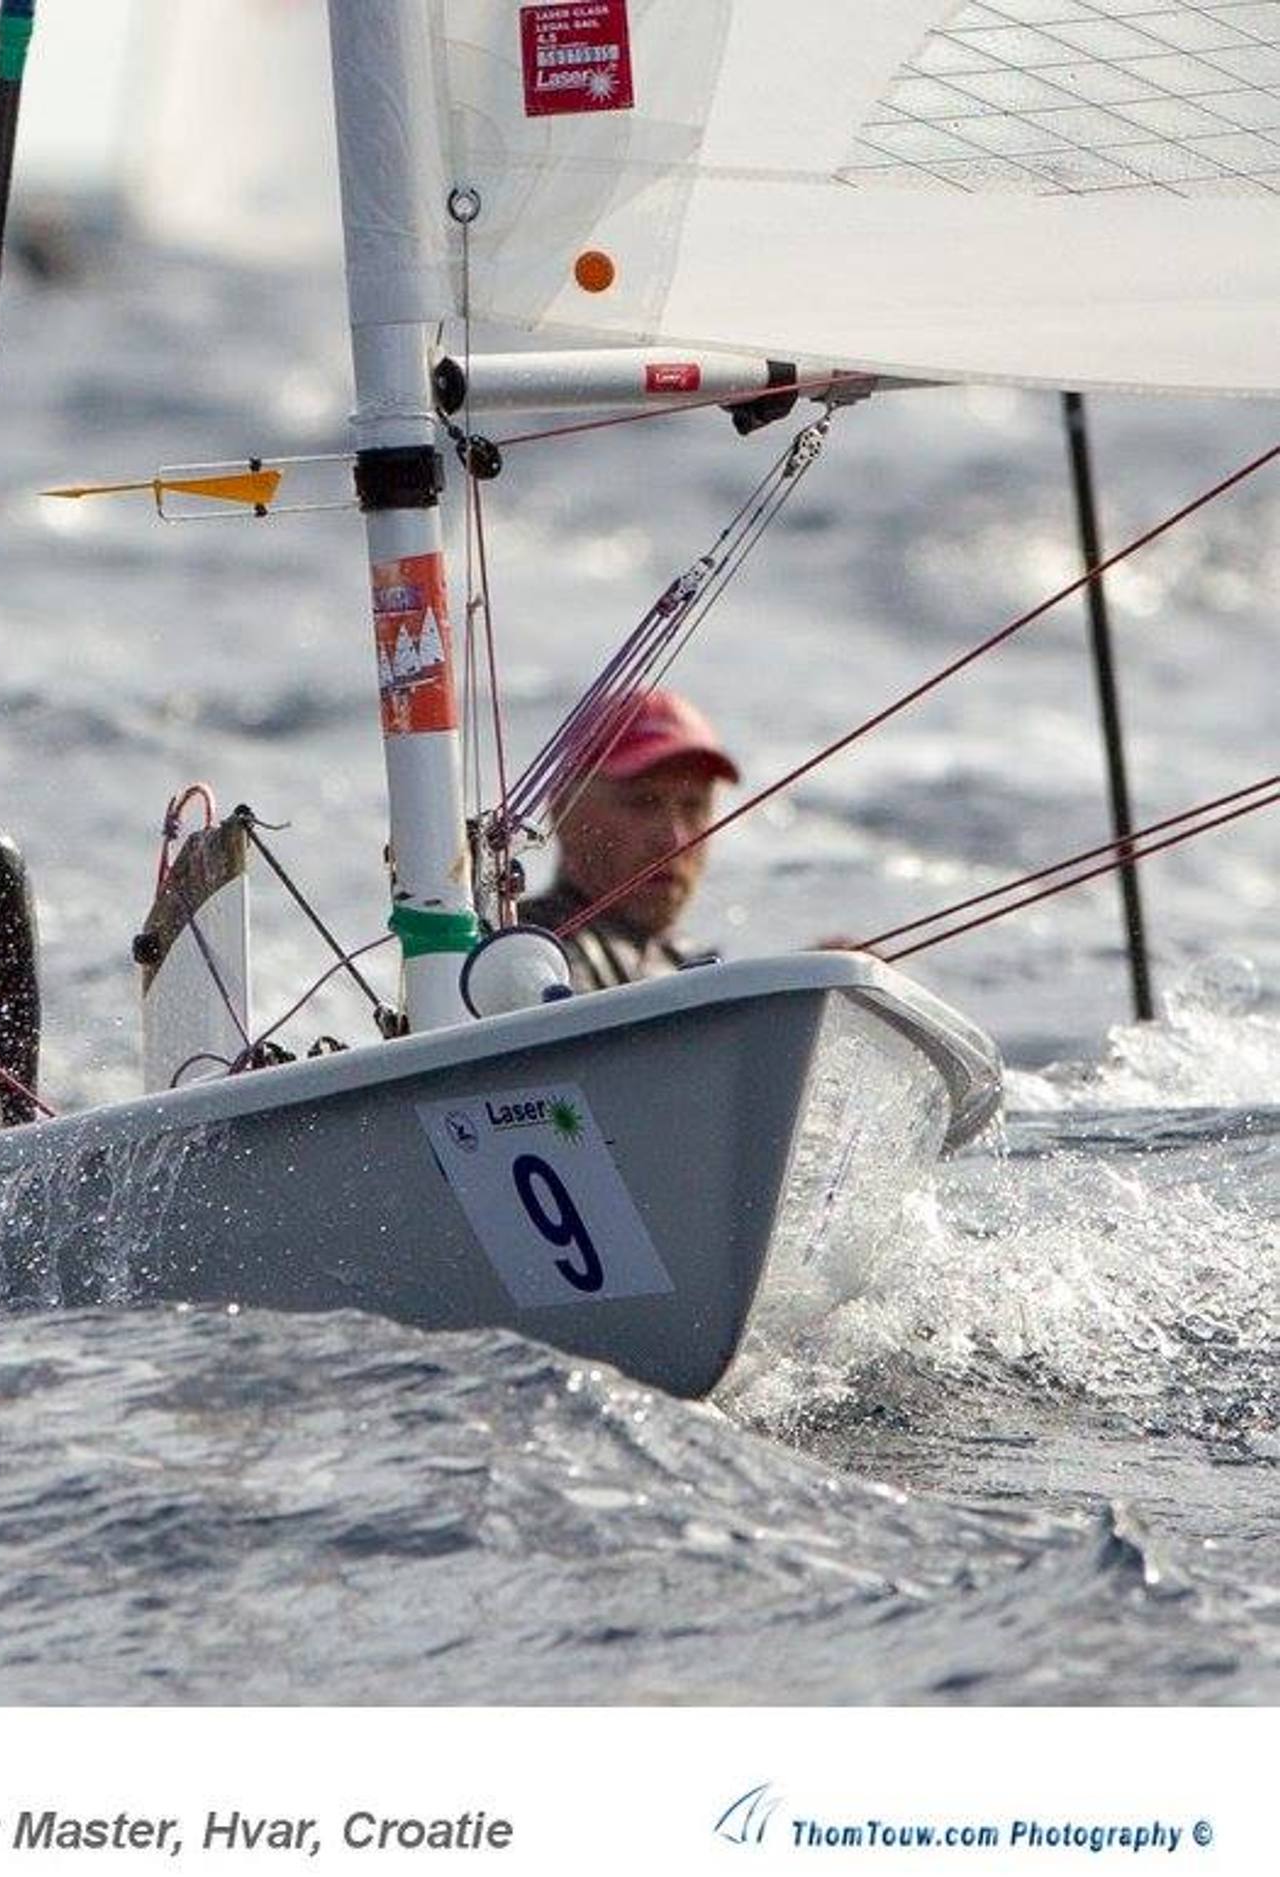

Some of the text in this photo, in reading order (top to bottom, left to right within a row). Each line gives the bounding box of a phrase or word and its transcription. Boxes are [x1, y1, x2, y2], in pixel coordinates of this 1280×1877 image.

[536, 69, 589, 87] Laser
[485, 1100, 547, 1126] Laser
[513, 1154, 604, 1293] 9
